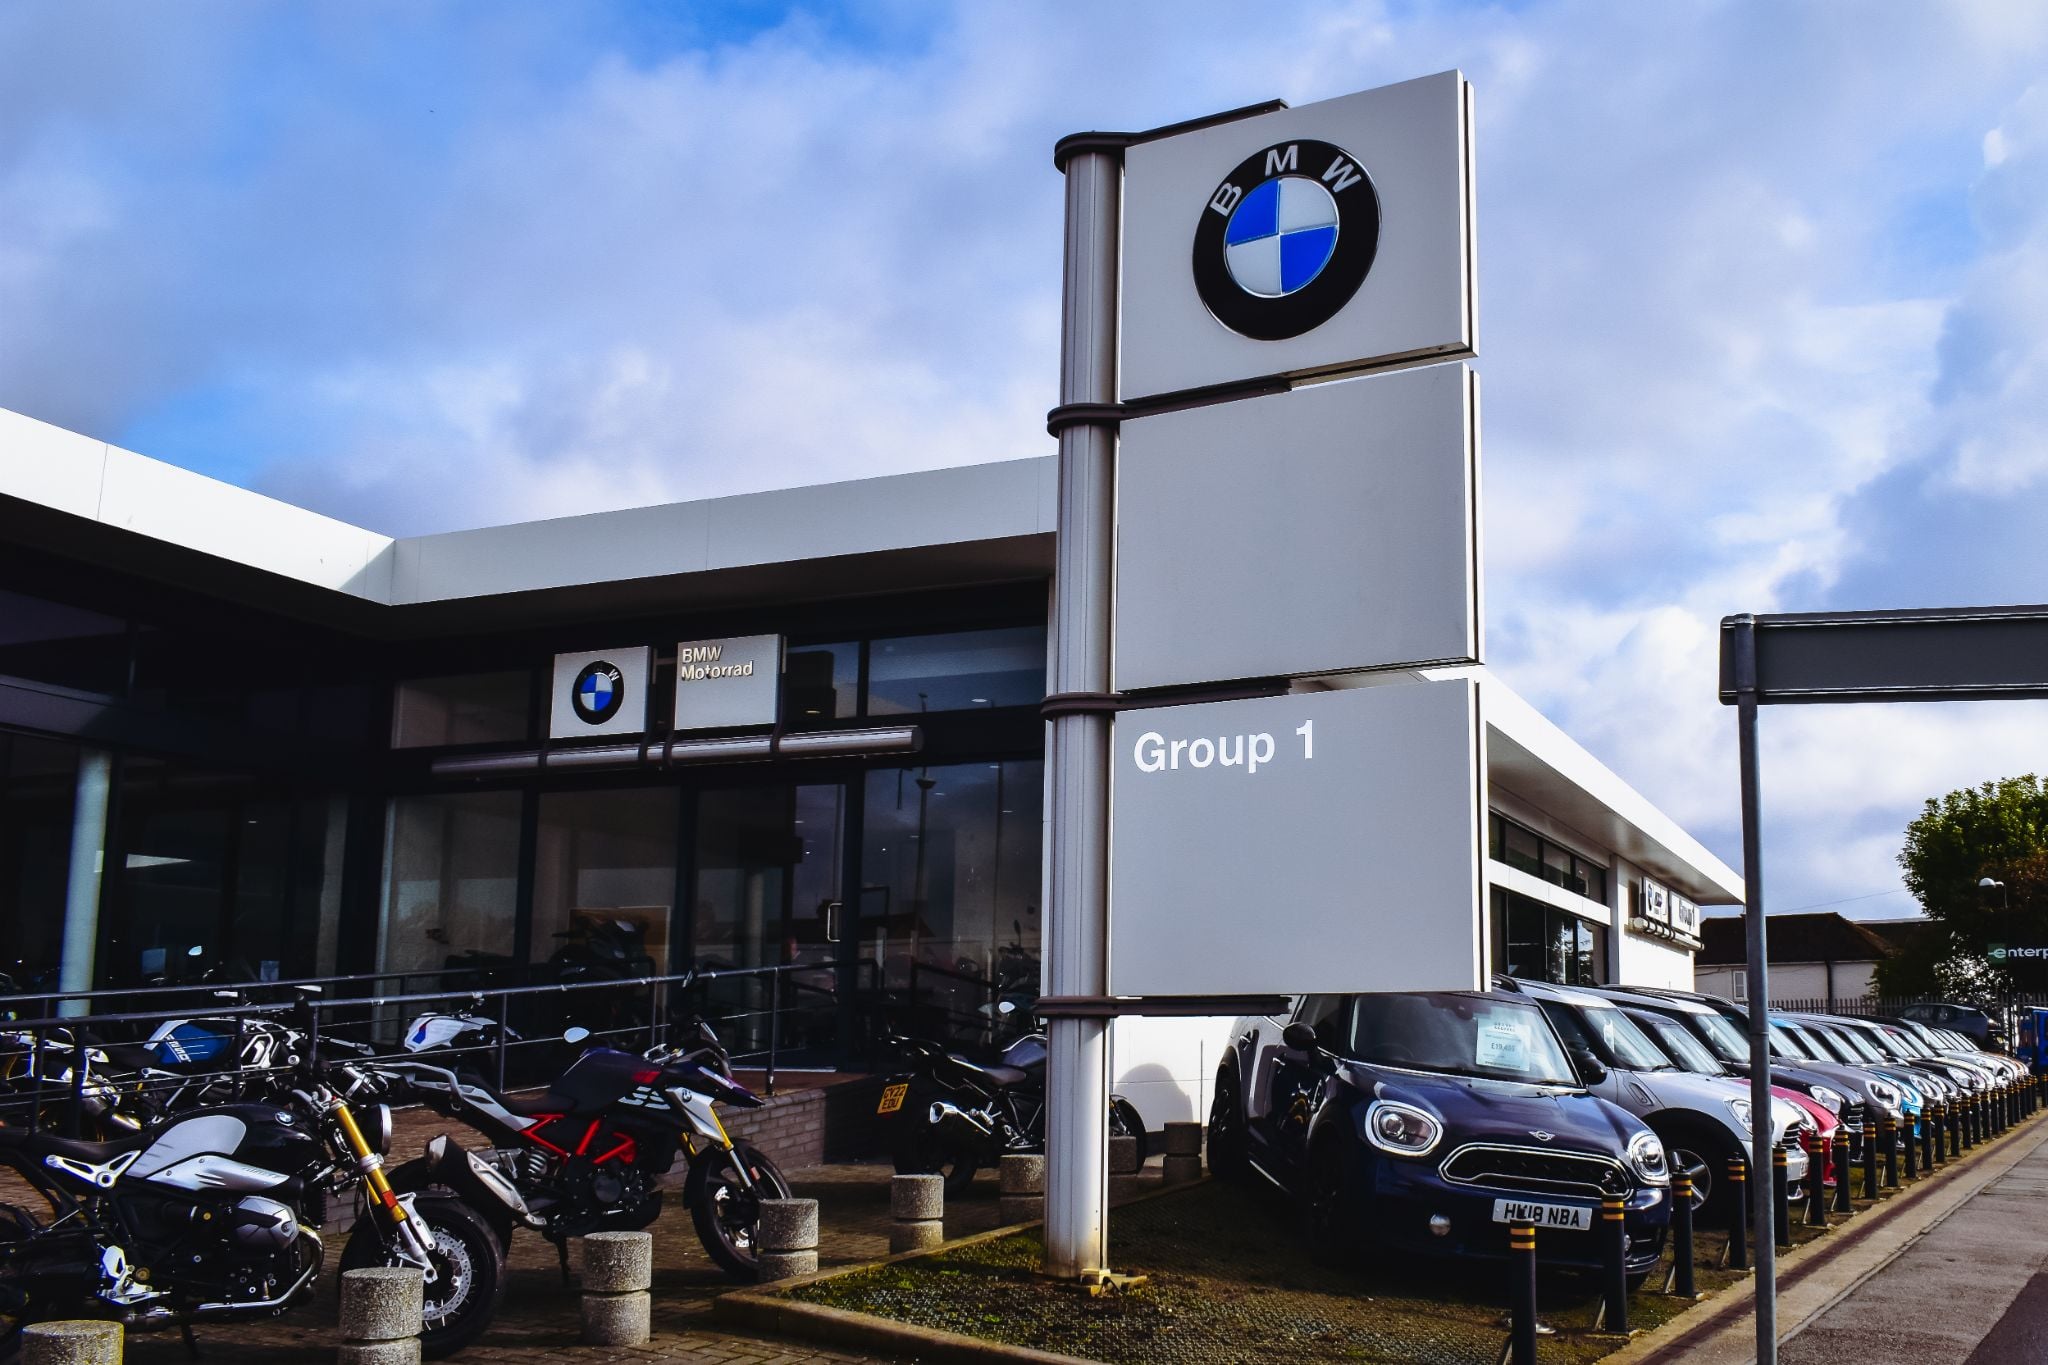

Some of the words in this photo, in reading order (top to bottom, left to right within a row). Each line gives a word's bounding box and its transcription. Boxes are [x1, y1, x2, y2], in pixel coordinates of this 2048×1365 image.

[1210, 144, 1362, 217] BMW
[682, 645, 722, 663] BMW
[681, 660, 754, 680] Motorrad
[1134, 731, 1275, 774] Group
[1296, 719, 1313, 760] 1
[1547, 1207, 1580, 1227] NBA
